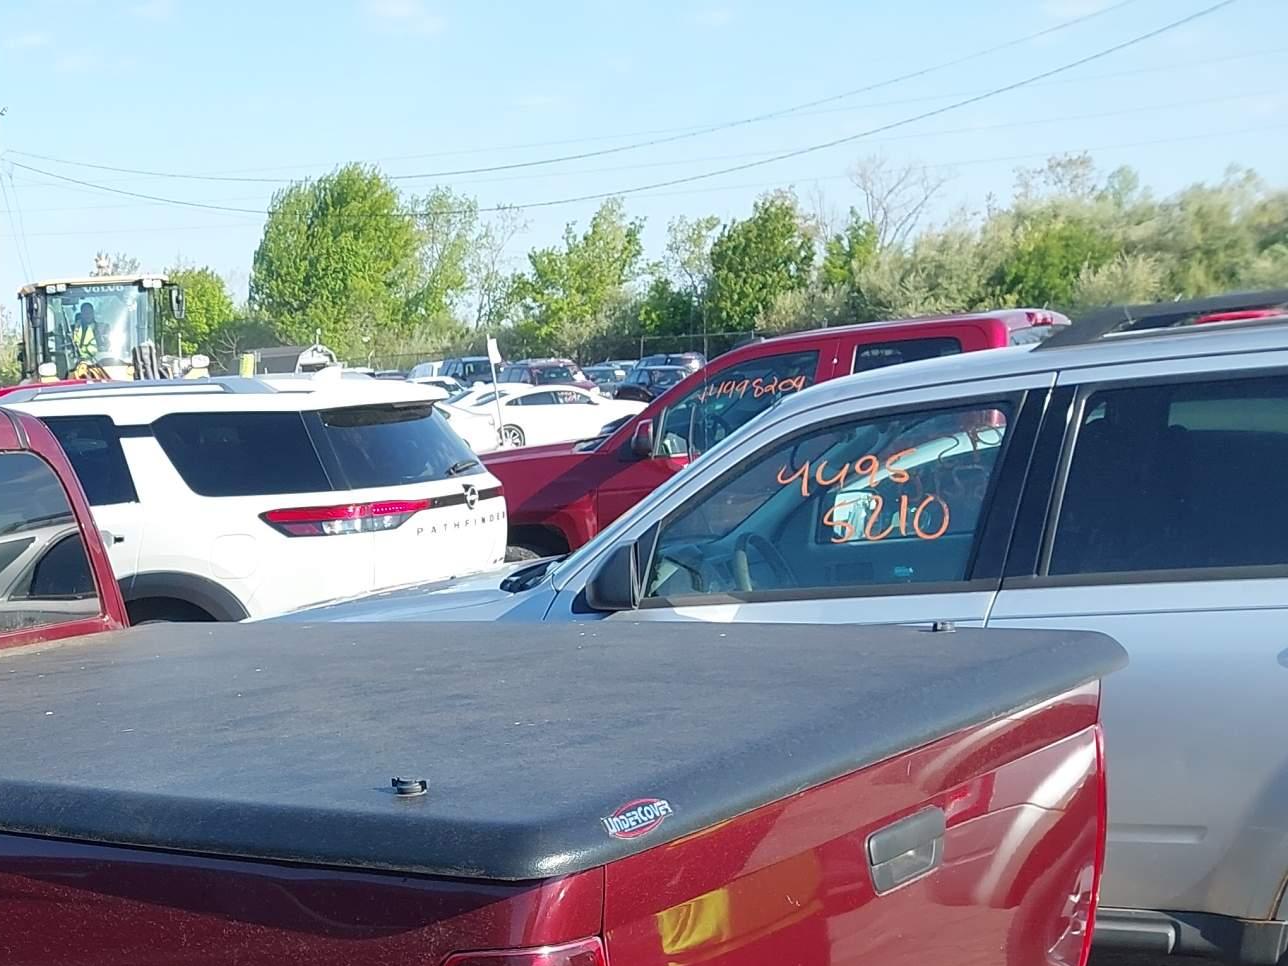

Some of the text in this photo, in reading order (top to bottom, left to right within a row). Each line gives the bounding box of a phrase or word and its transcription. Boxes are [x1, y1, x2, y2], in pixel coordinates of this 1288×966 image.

[83, 285, 125, 294] VOLVO
[776, 447, 918, 497] 4495
[823, 494, 950, 544] 5210
[600, 800, 673, 835] UNDERCOVER
